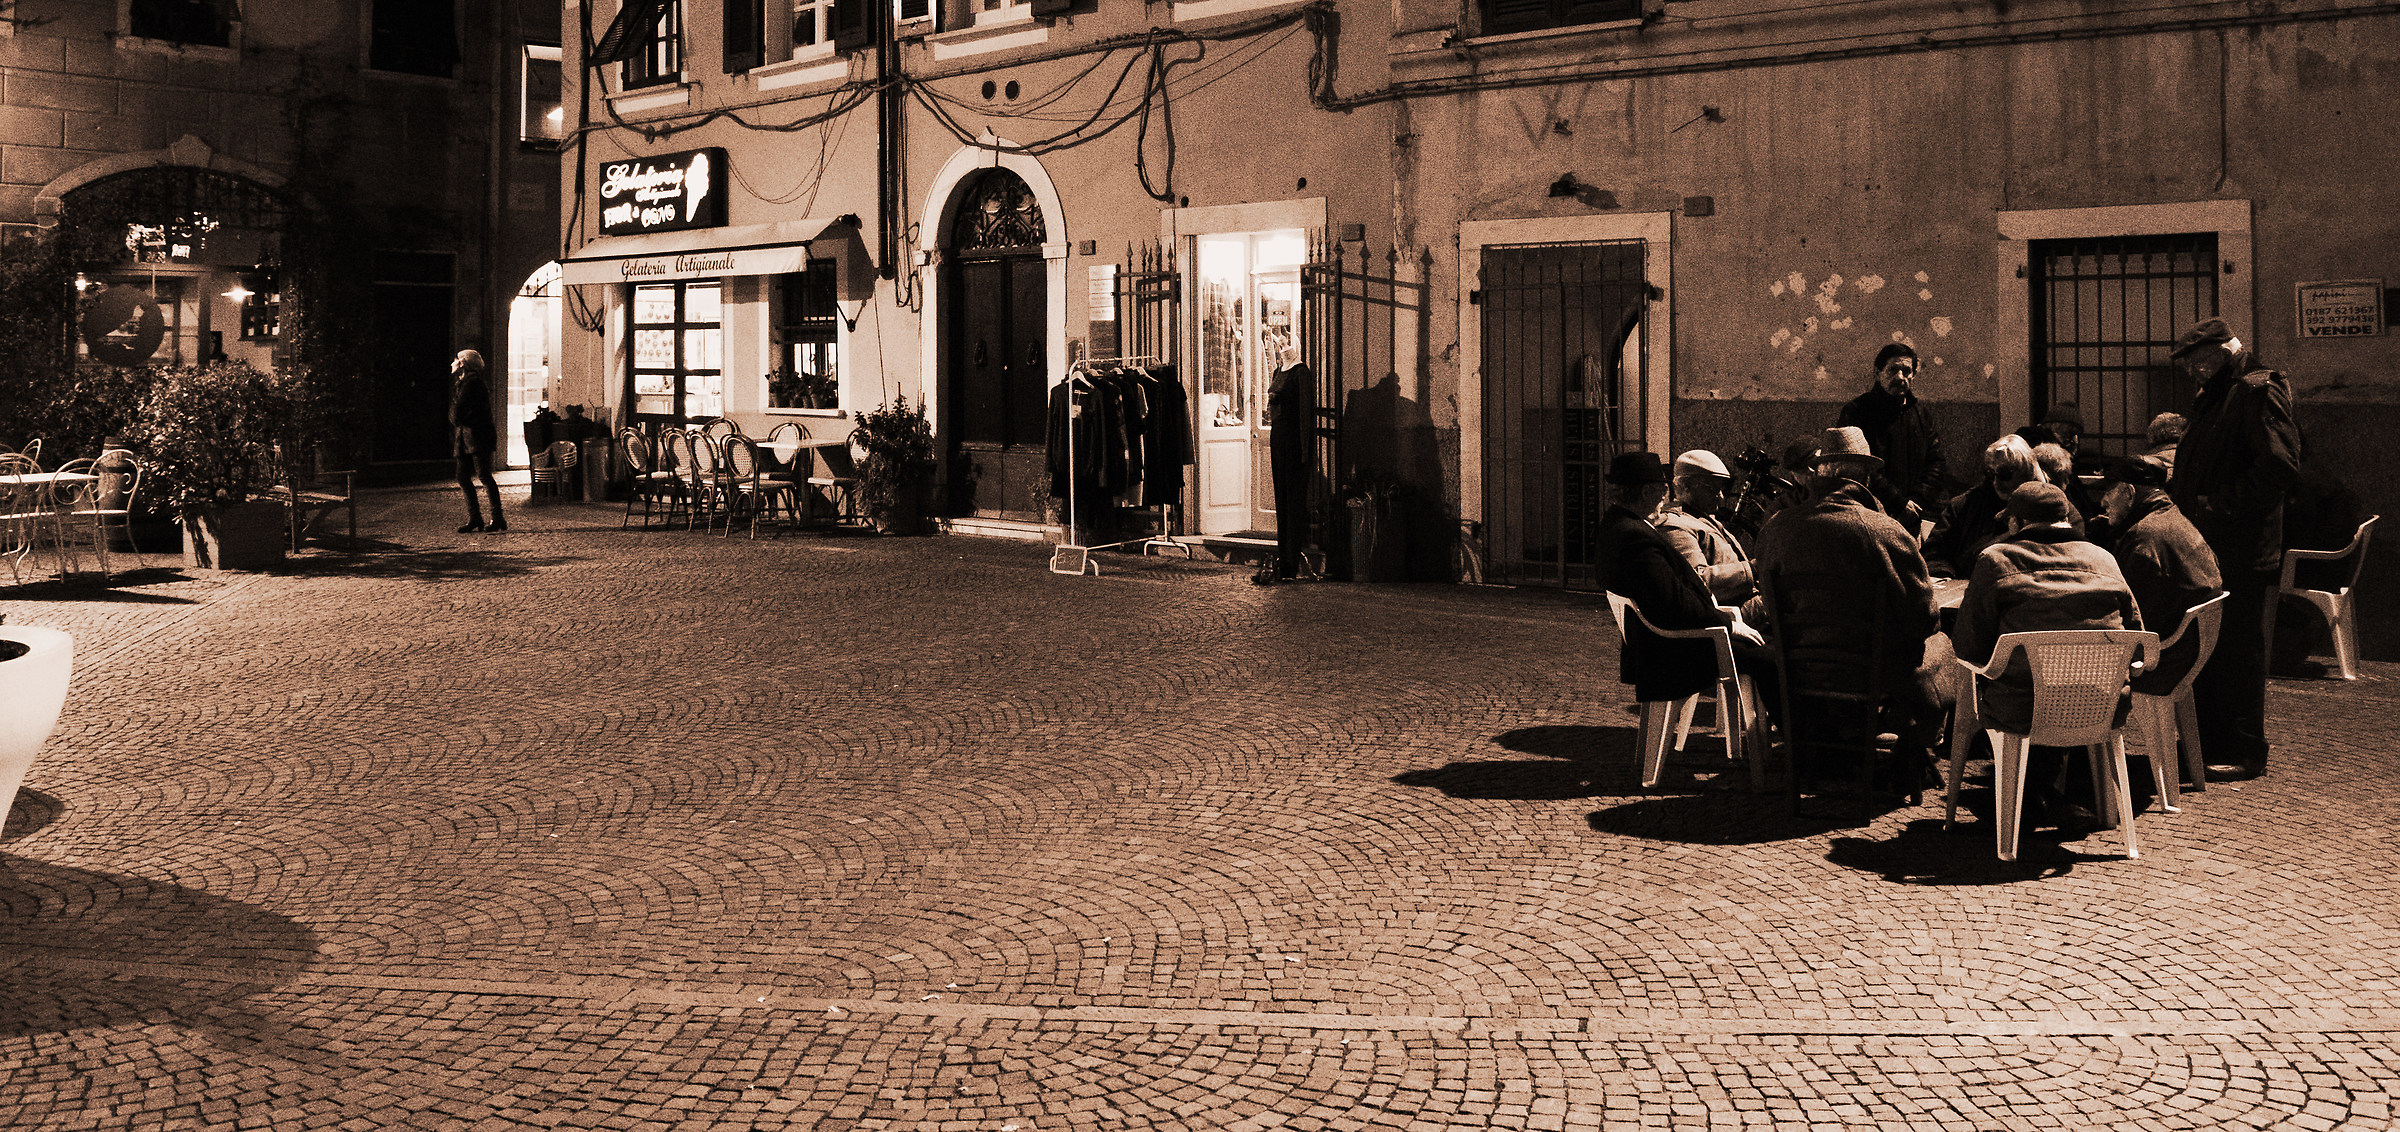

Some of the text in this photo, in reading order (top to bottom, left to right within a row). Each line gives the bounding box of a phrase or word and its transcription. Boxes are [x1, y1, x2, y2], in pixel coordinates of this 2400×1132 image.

[621, 252, 735, 282] Gelateria Artigianale
[2305, 306, 2374, 316] 0187 621367
[1268, 315, 1288, 325] OPEN
[2306, 316, 2327, 325] 392
[2308, 325, 2373, 336] VENDE
